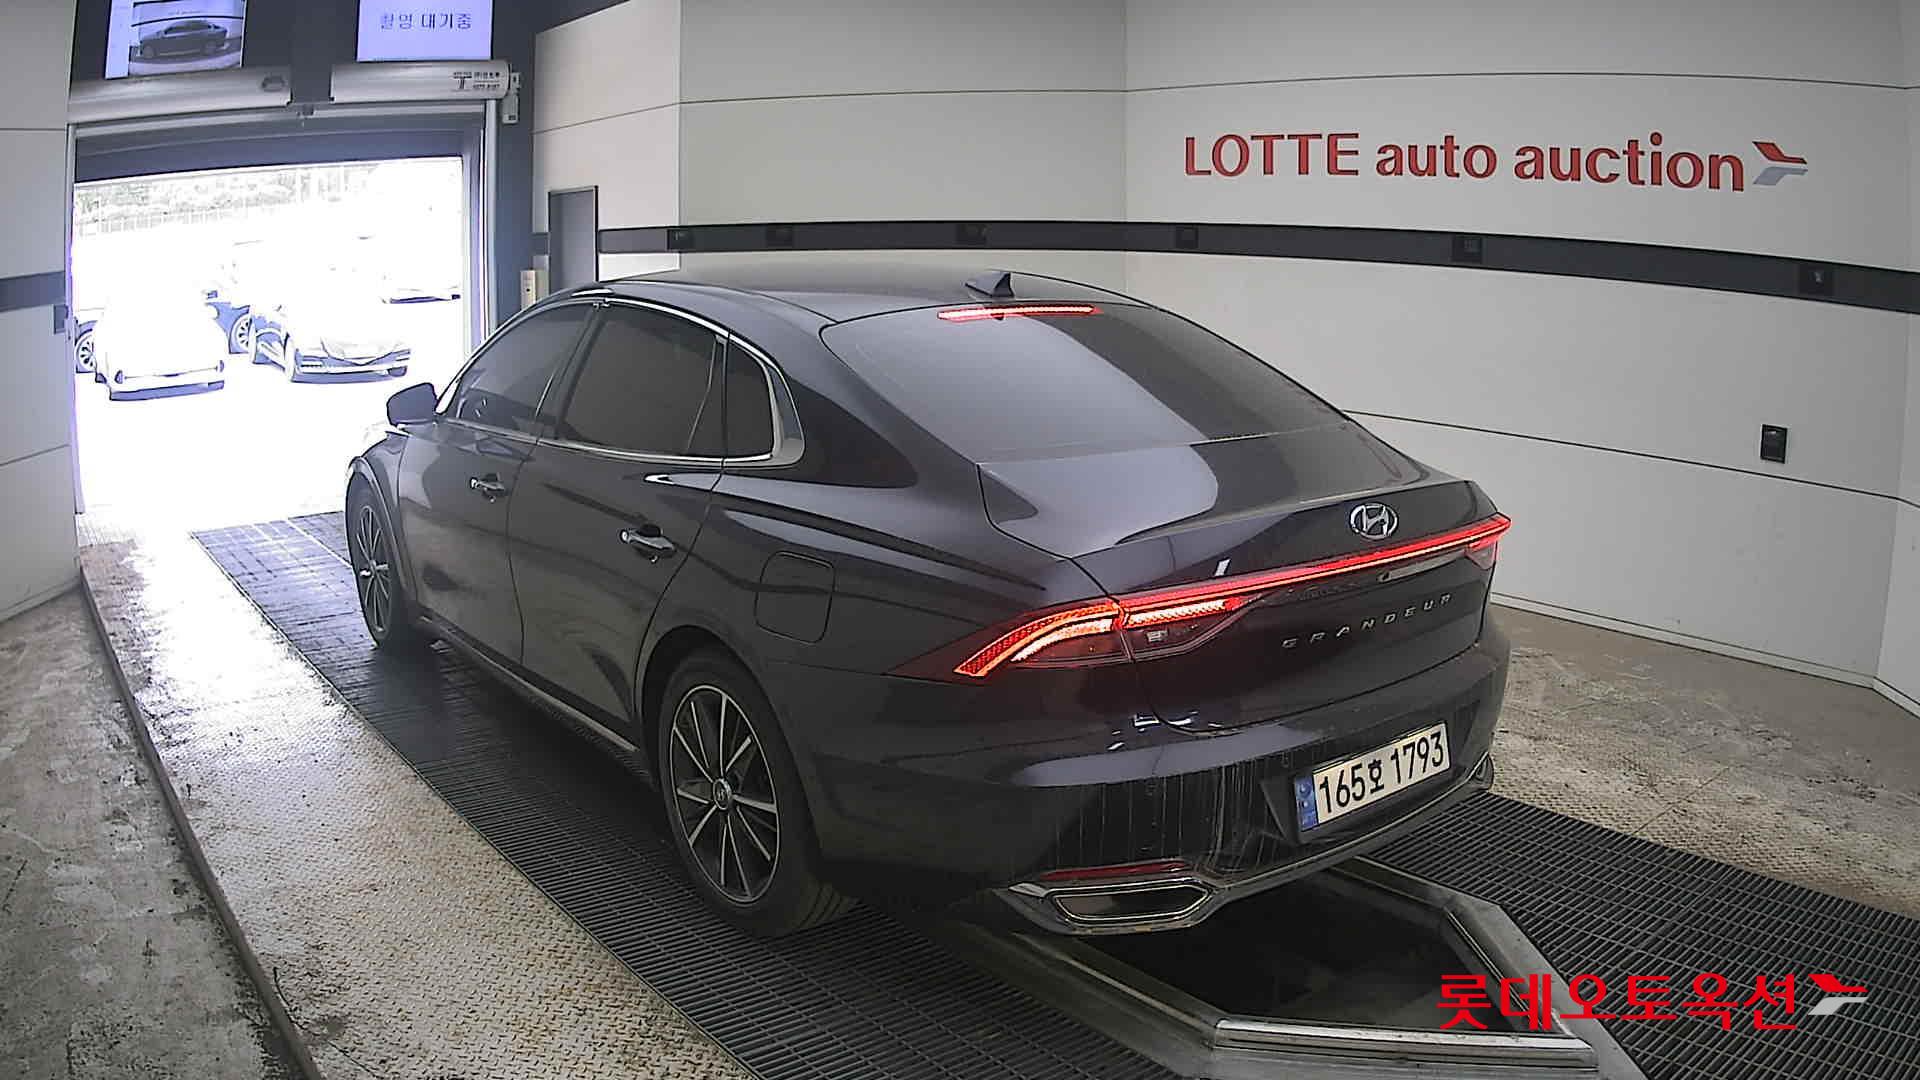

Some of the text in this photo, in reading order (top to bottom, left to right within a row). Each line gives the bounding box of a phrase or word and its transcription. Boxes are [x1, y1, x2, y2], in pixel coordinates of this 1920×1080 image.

[421, 13, 472, 30] 대기중
[1184, 131, 1744, 192] LOTTE auto auction
[1281, 593, 1452, 649] GRANDEUR
[1319, 731, 1444, 814] 165호 1793
